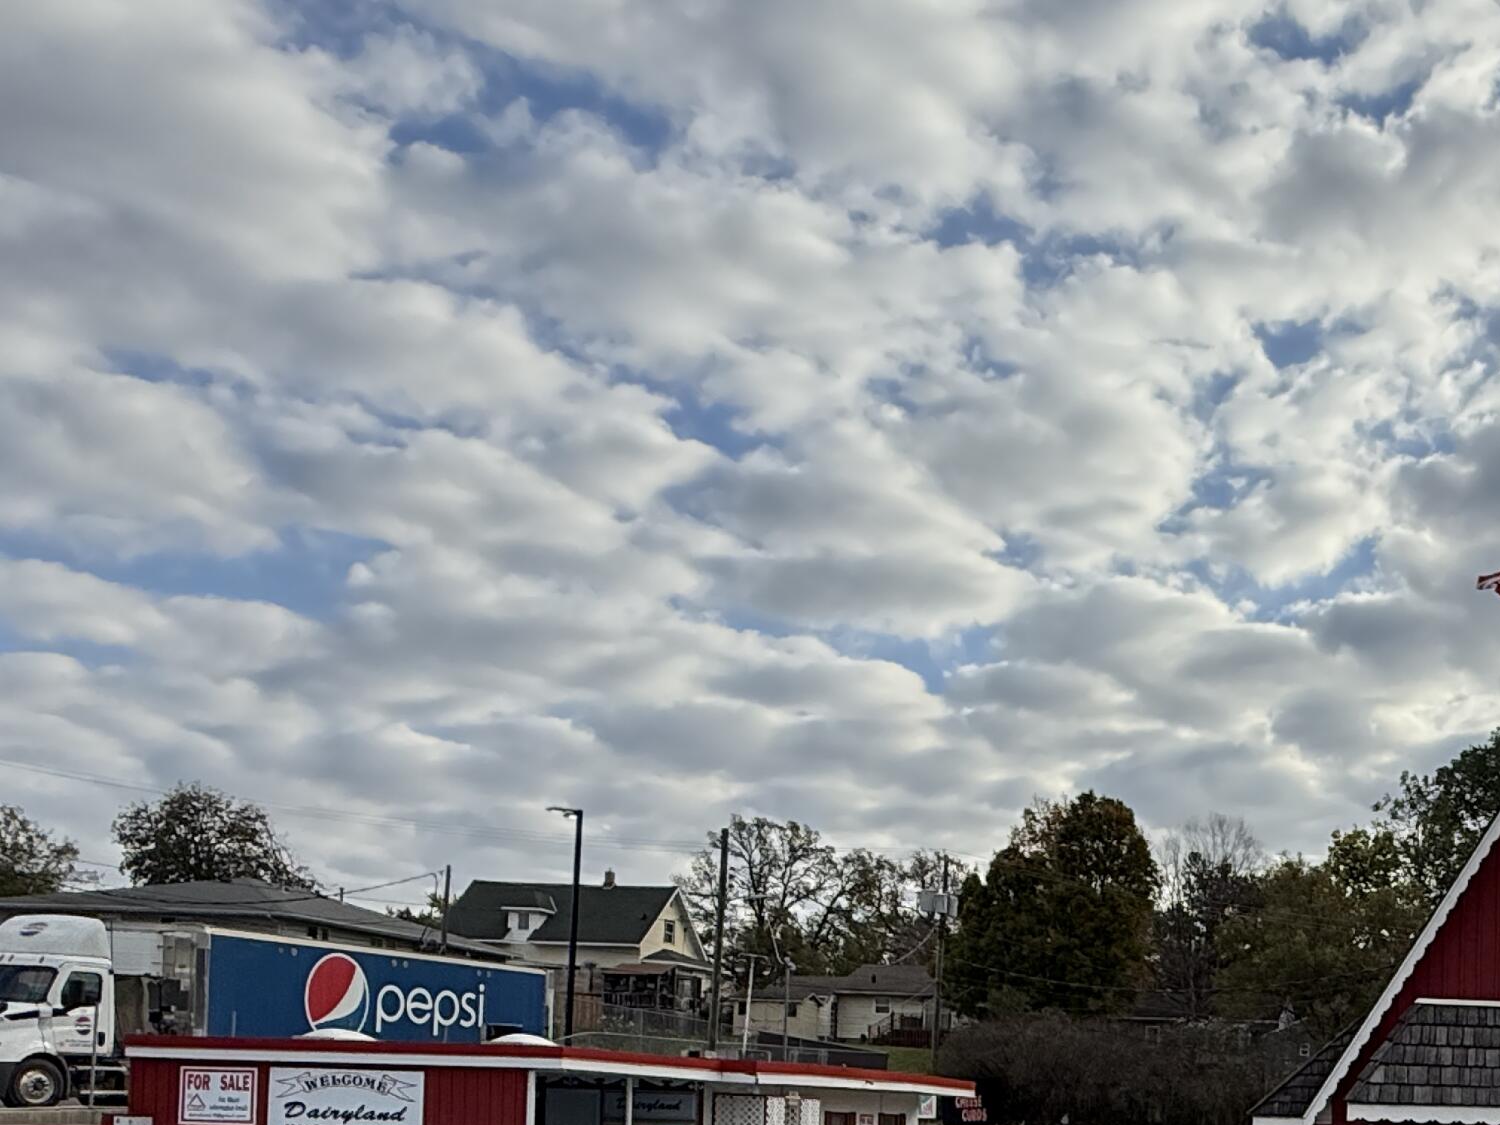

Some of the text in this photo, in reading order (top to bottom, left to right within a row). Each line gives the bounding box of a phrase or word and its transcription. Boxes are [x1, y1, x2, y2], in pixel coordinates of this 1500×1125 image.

[375, 983, 486, 1037] pepsi
[187, 1074, 250, 1092] FOR SALE
[304, 1074, 388, 1096] WELCOME
[283, 1101, 408, 1125] Dairyland
